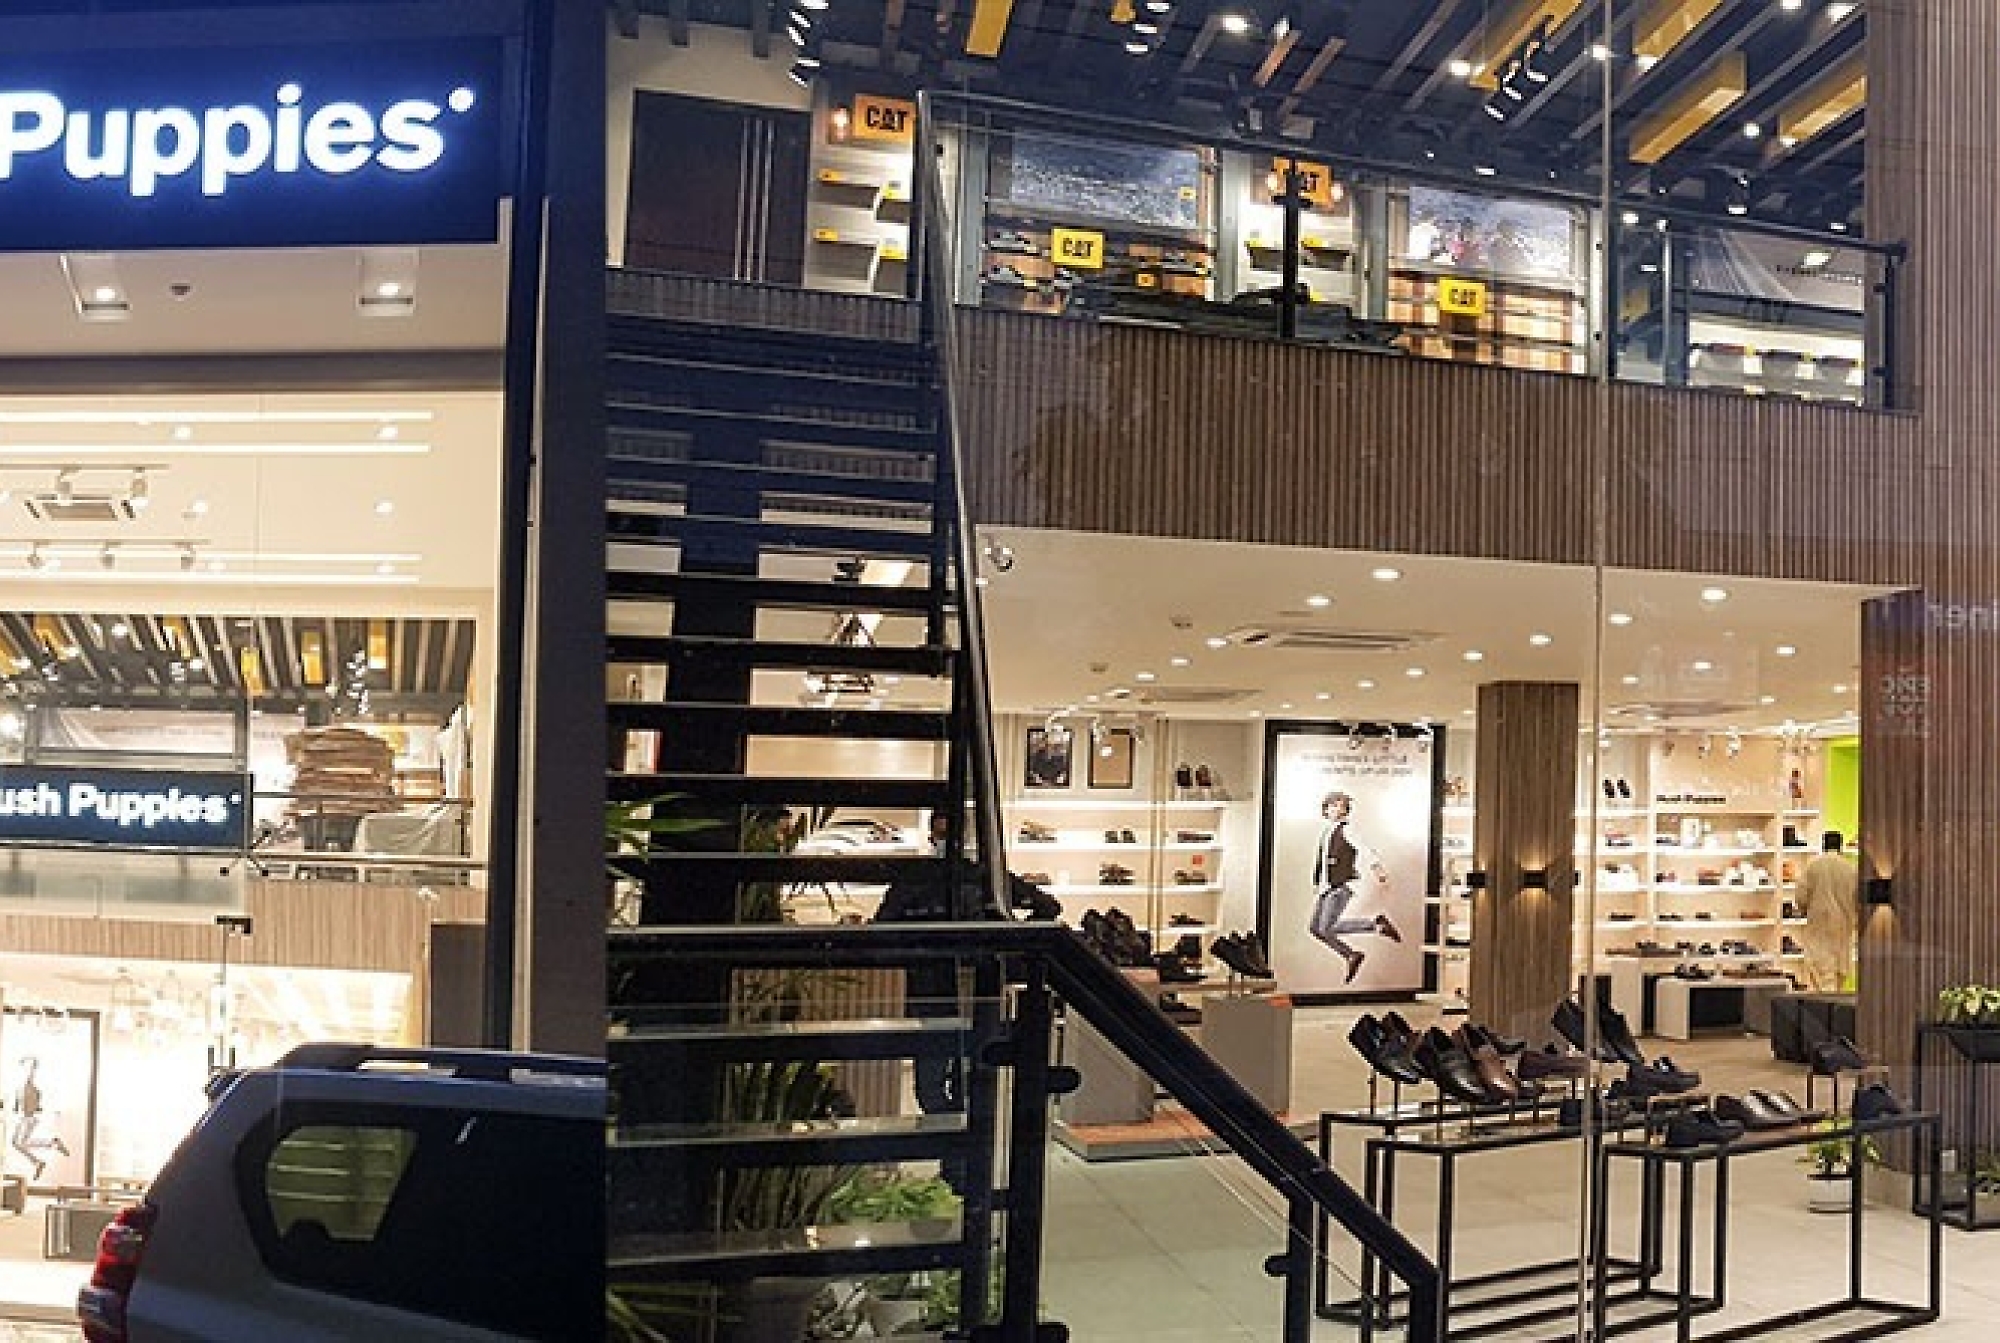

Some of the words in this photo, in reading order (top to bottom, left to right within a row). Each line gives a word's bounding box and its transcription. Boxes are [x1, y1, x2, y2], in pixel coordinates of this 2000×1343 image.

[866, 105, 909, 132] CAT
[0, 83, 446, 197] Puppies
[1062, 237, 1093, 257] CAT
[1449, 287, 1477, 307] CAT
[69, 782, 230, 828] Puppies
